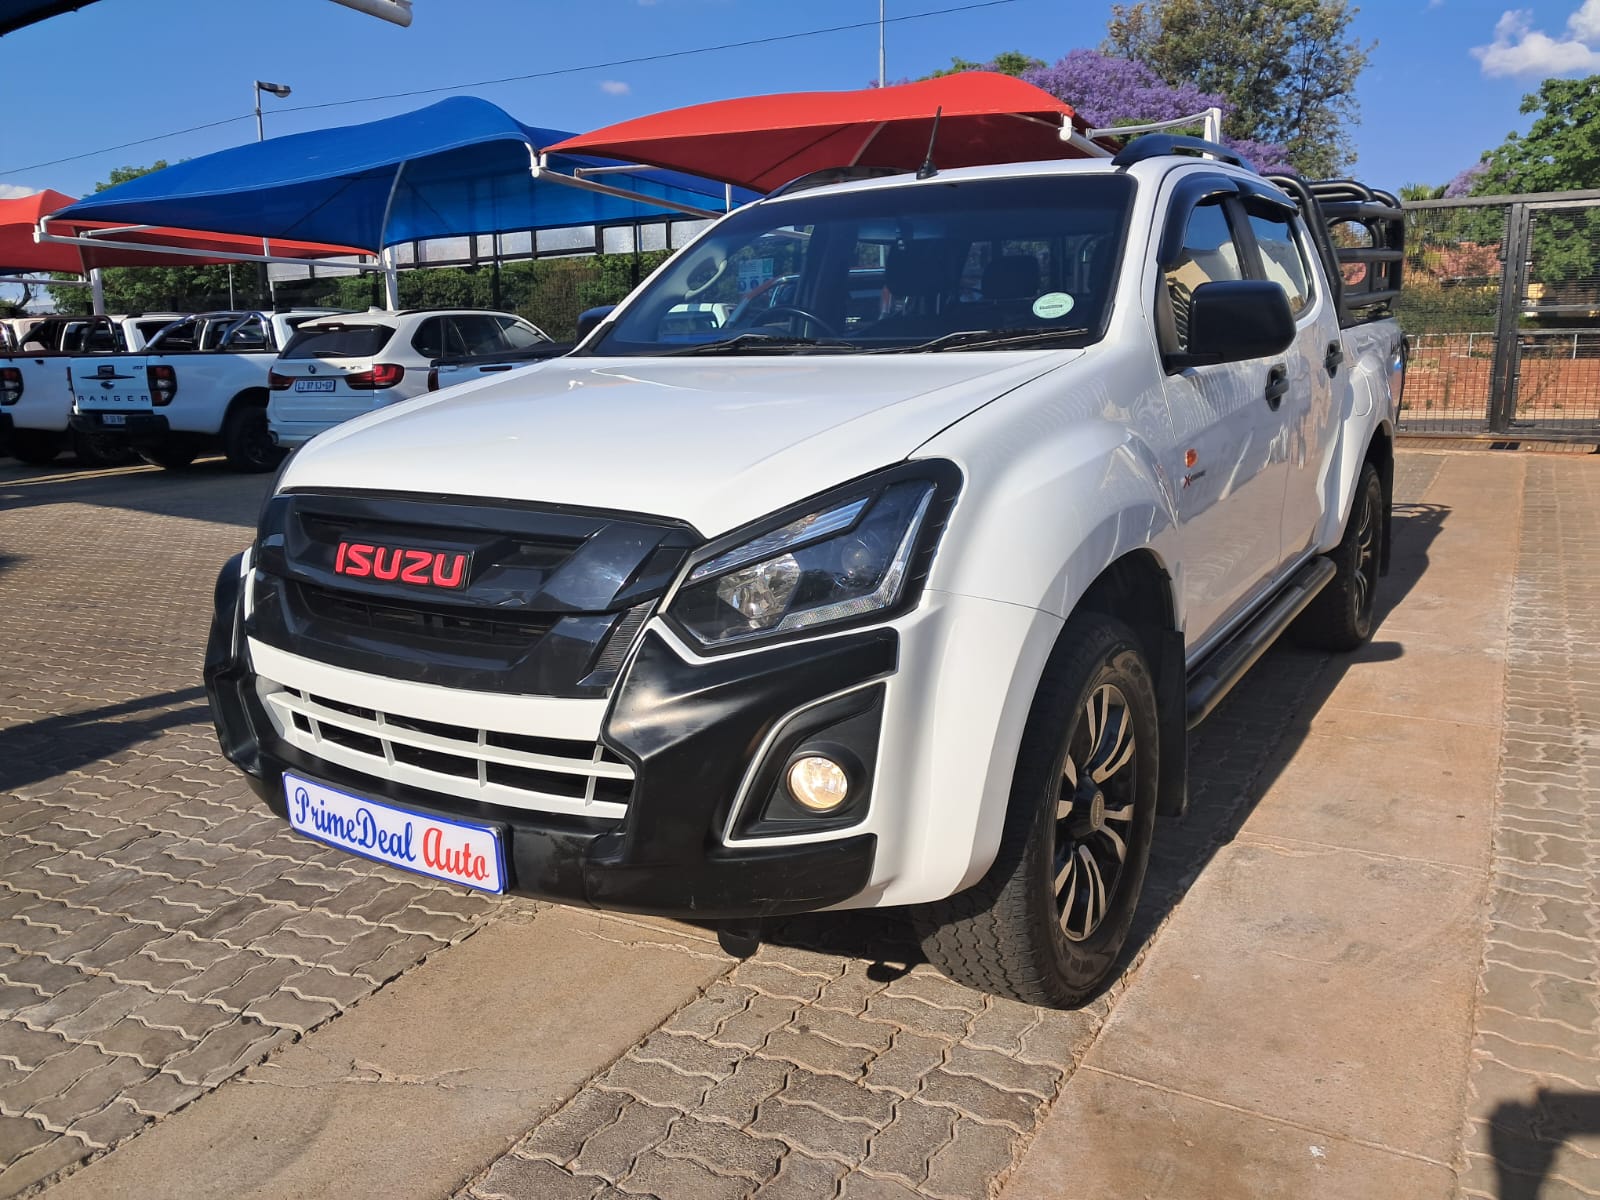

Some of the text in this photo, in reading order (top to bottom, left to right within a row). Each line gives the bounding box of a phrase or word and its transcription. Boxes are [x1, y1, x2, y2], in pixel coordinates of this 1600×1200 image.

[335, 542, 465, 587] ISUZU
[295, 786, 490, 881] PrimeDeal Auto
